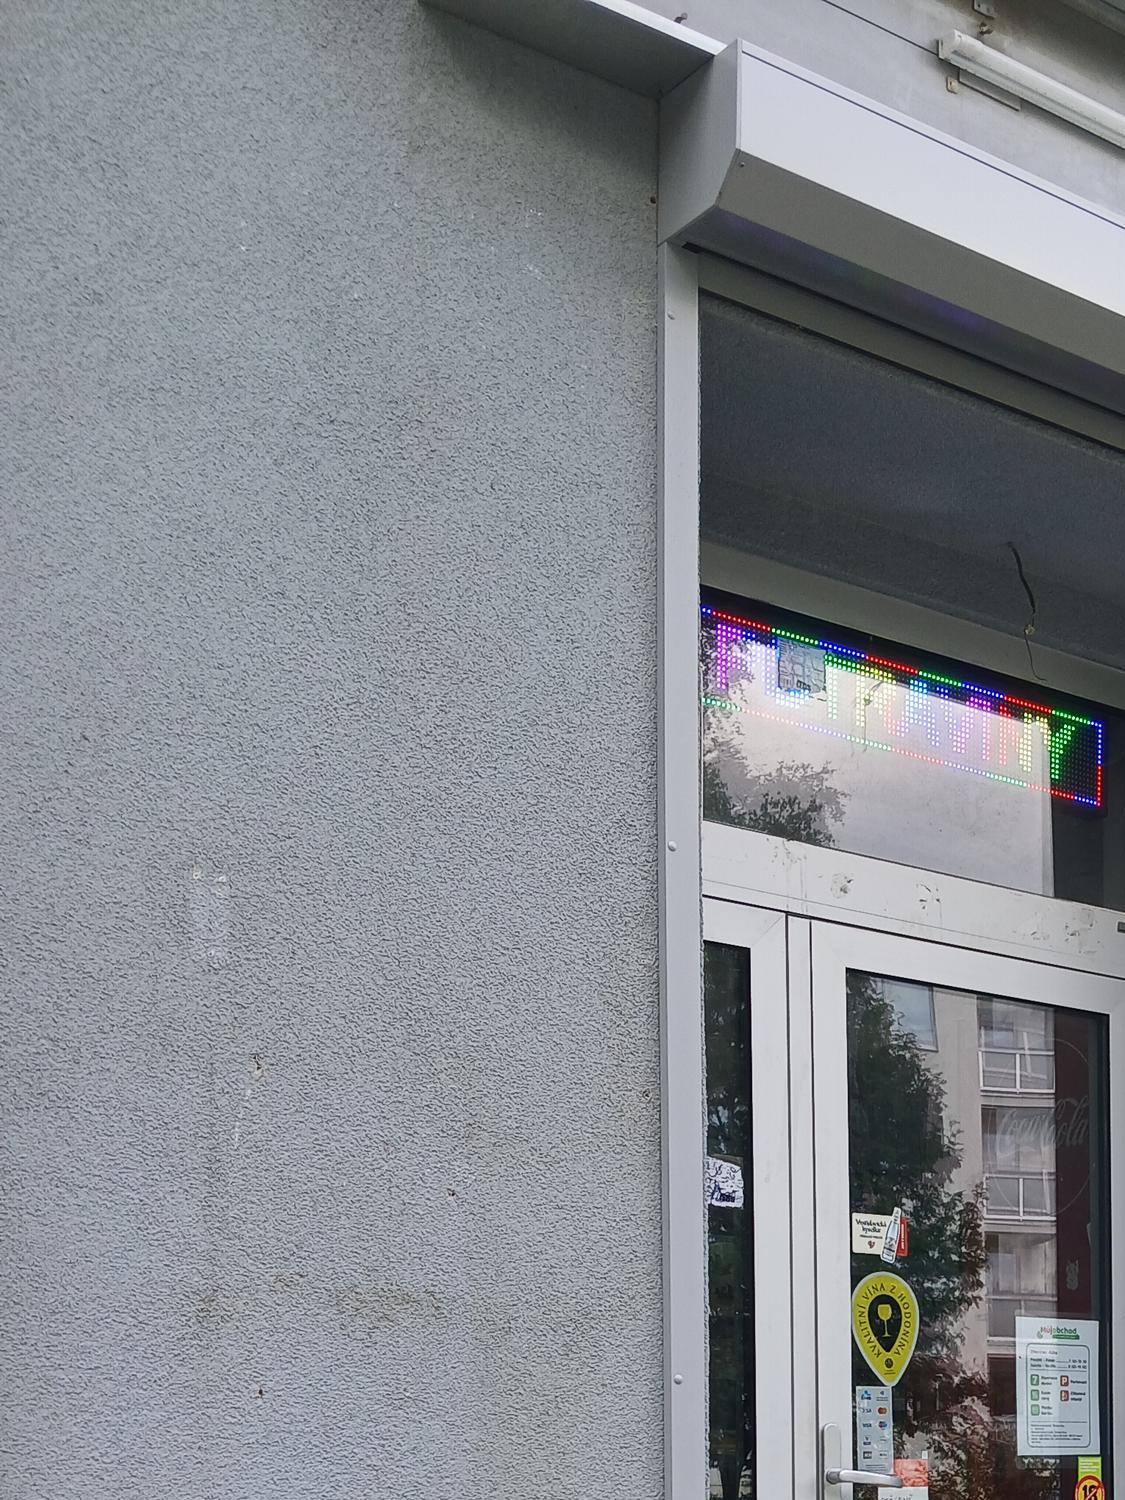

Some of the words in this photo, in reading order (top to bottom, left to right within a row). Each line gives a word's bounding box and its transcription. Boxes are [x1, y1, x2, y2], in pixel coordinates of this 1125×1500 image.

[862, 1282, 886, 1301] VÍNA
[889, 1284, 897, 1294] Z
[856, 1303, 882, 1358] KVALITNÍ
[897, 1293, 912, 1357] HODONÍNA
